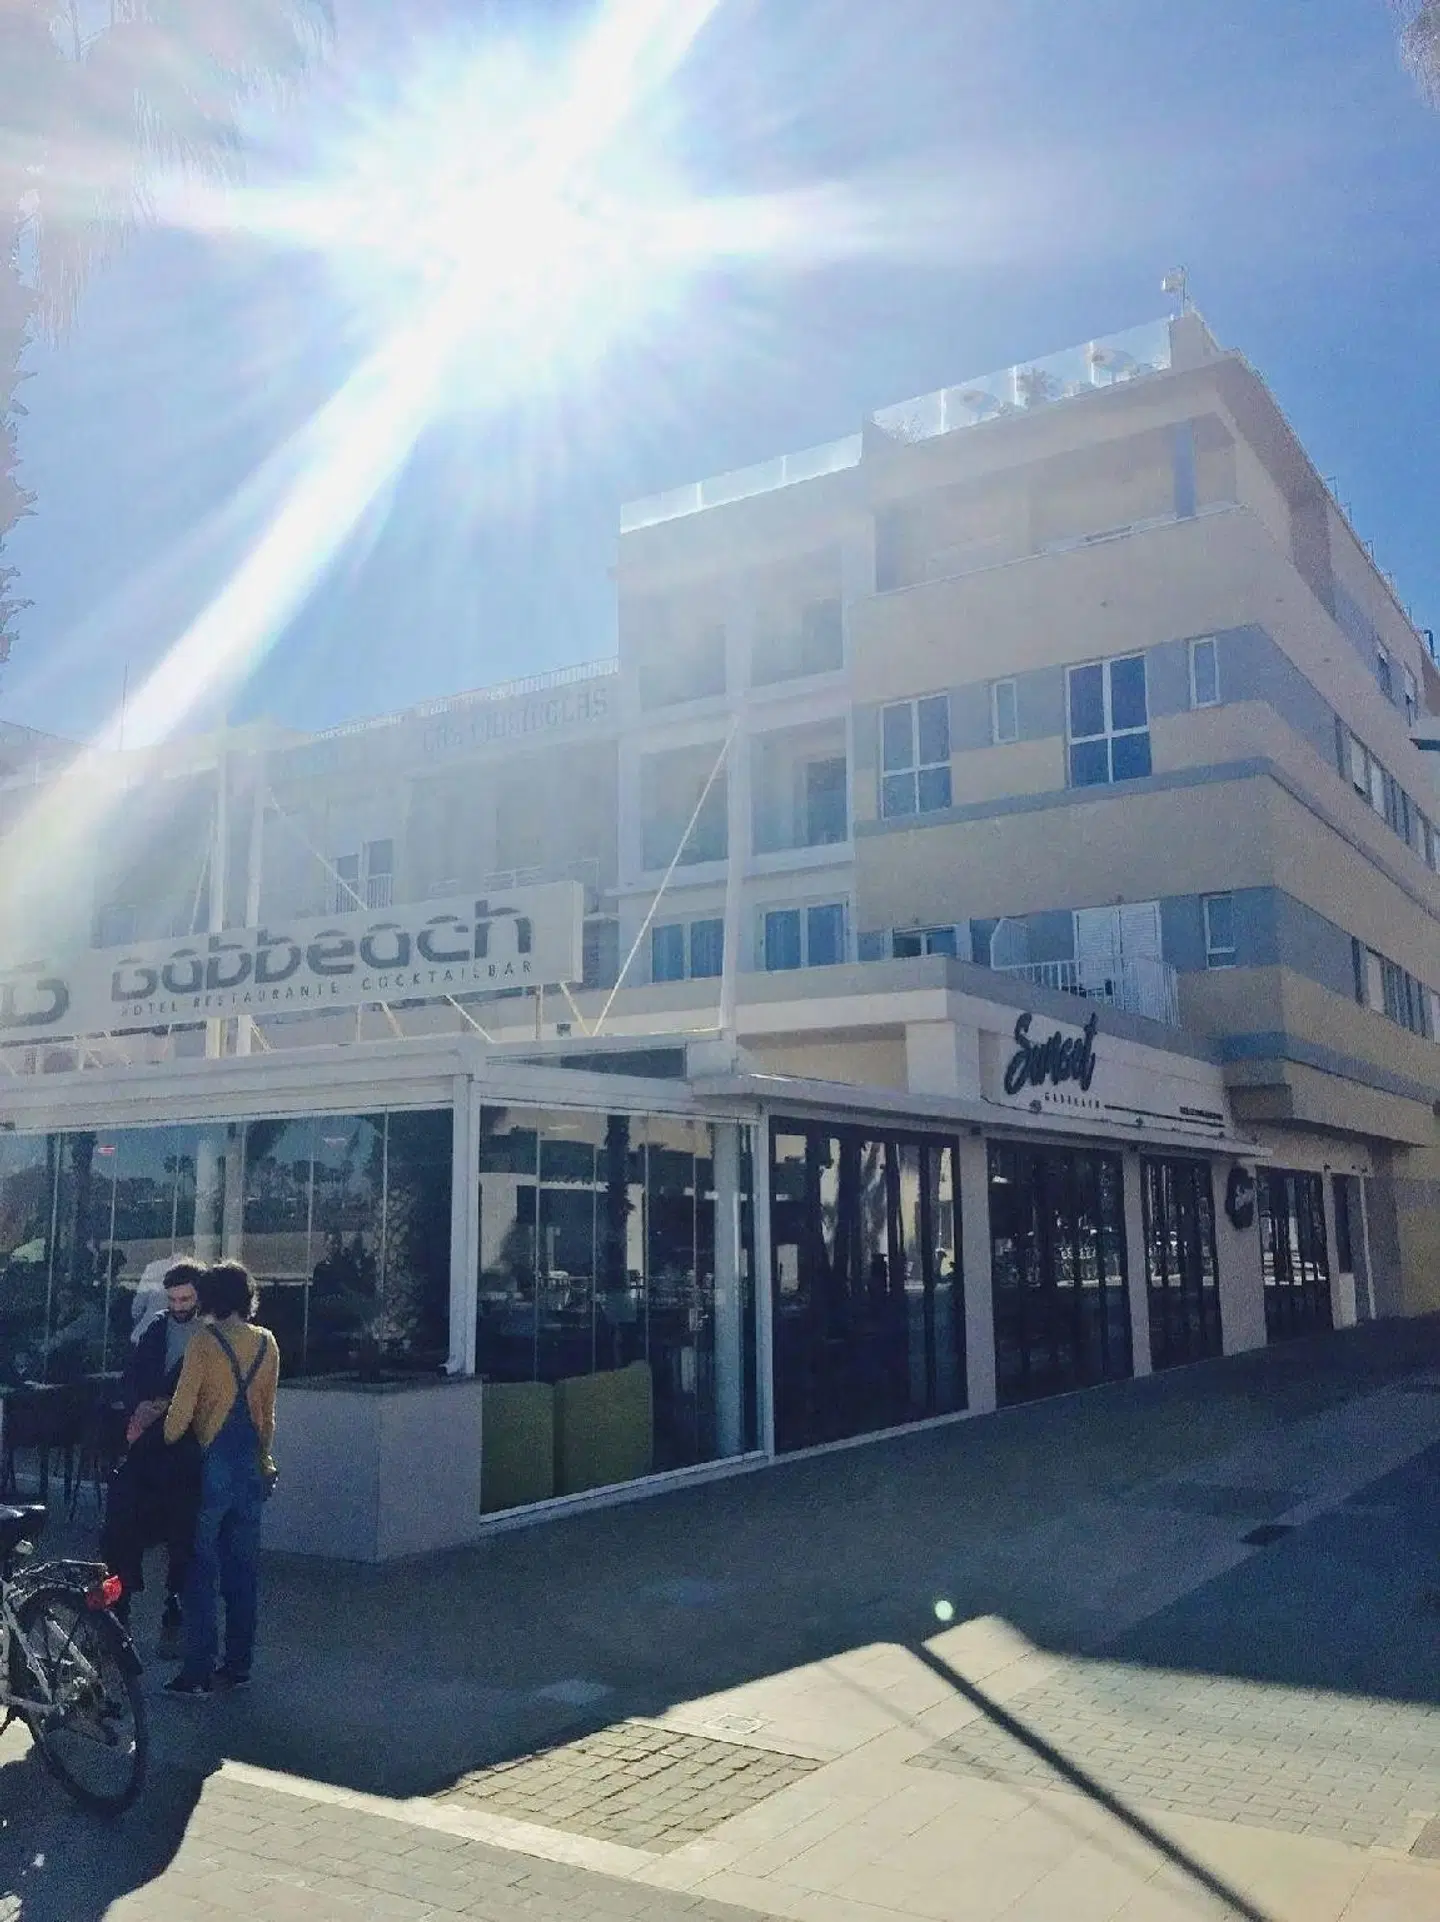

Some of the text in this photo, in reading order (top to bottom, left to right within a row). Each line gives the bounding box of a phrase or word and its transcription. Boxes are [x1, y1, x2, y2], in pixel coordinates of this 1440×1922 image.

[121, 961, 531, 1017] HOTEL RESTAURANTE COCKTAILBAR
